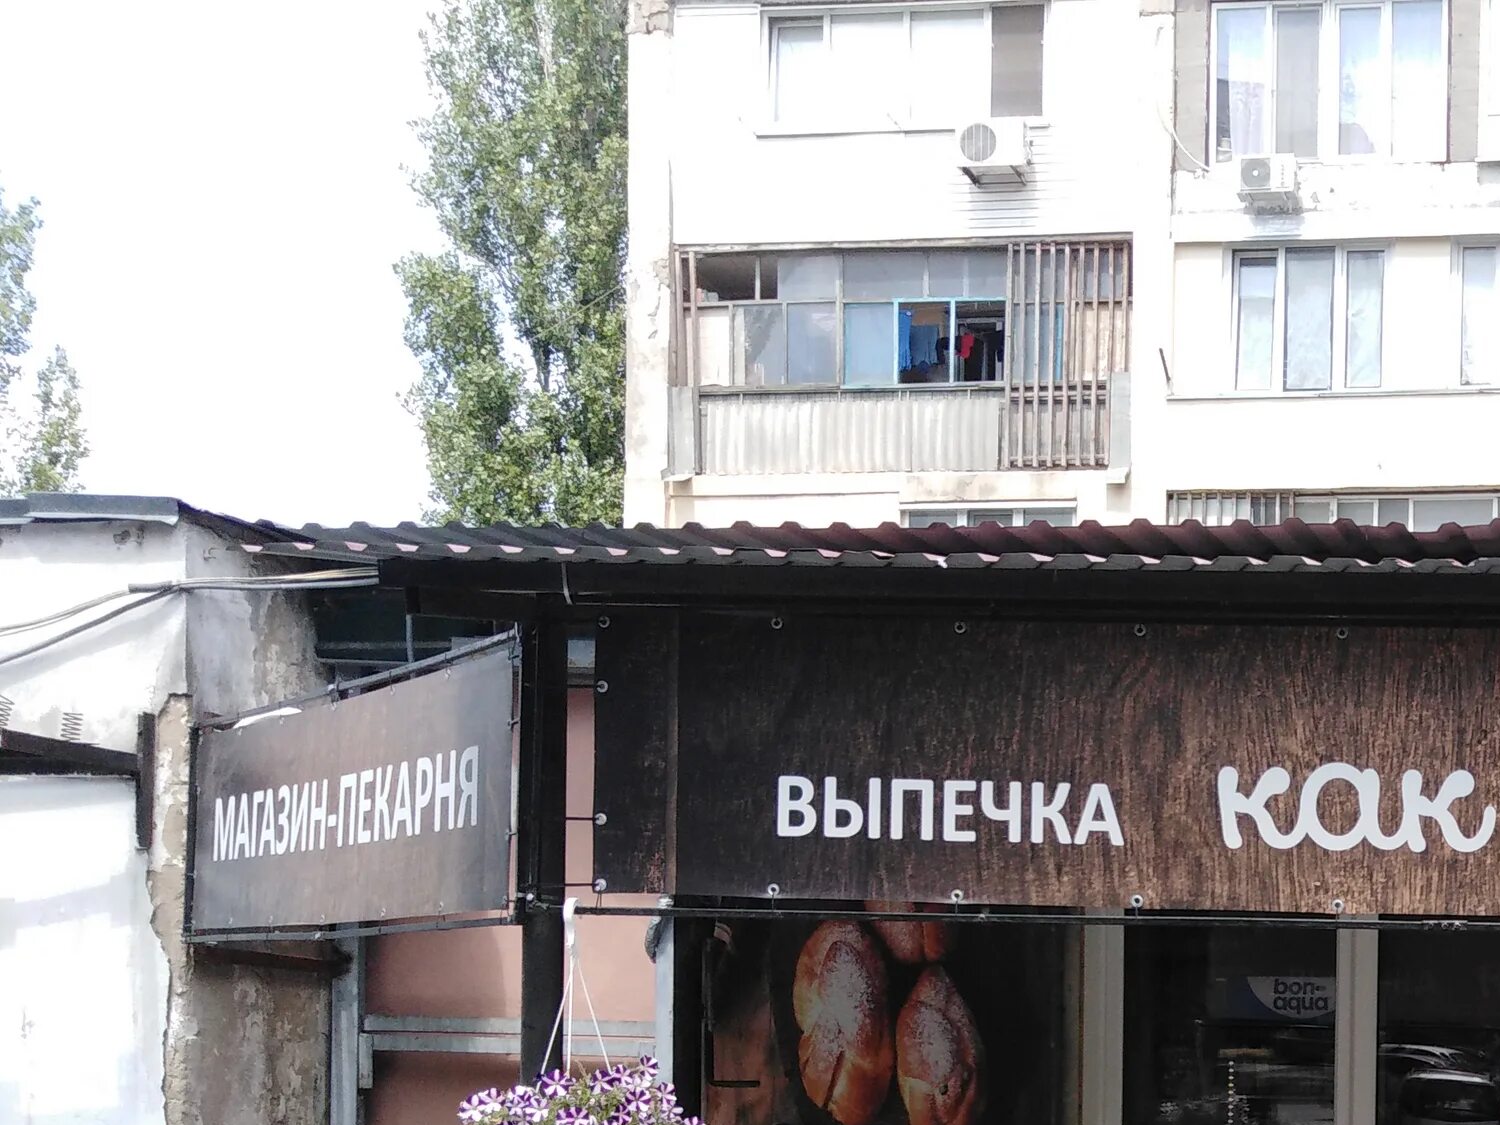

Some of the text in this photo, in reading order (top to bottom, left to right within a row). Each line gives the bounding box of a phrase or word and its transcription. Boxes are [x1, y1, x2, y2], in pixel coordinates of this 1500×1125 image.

[211, 745, 481, 862] МАГАЗИН-ПЕКАРНЯ
[776, 774, 1125, 848] ВЫПЕЧКА
[1217, 761, 1496, 853] как
[1273, 996, 1329, 1015] aqua
